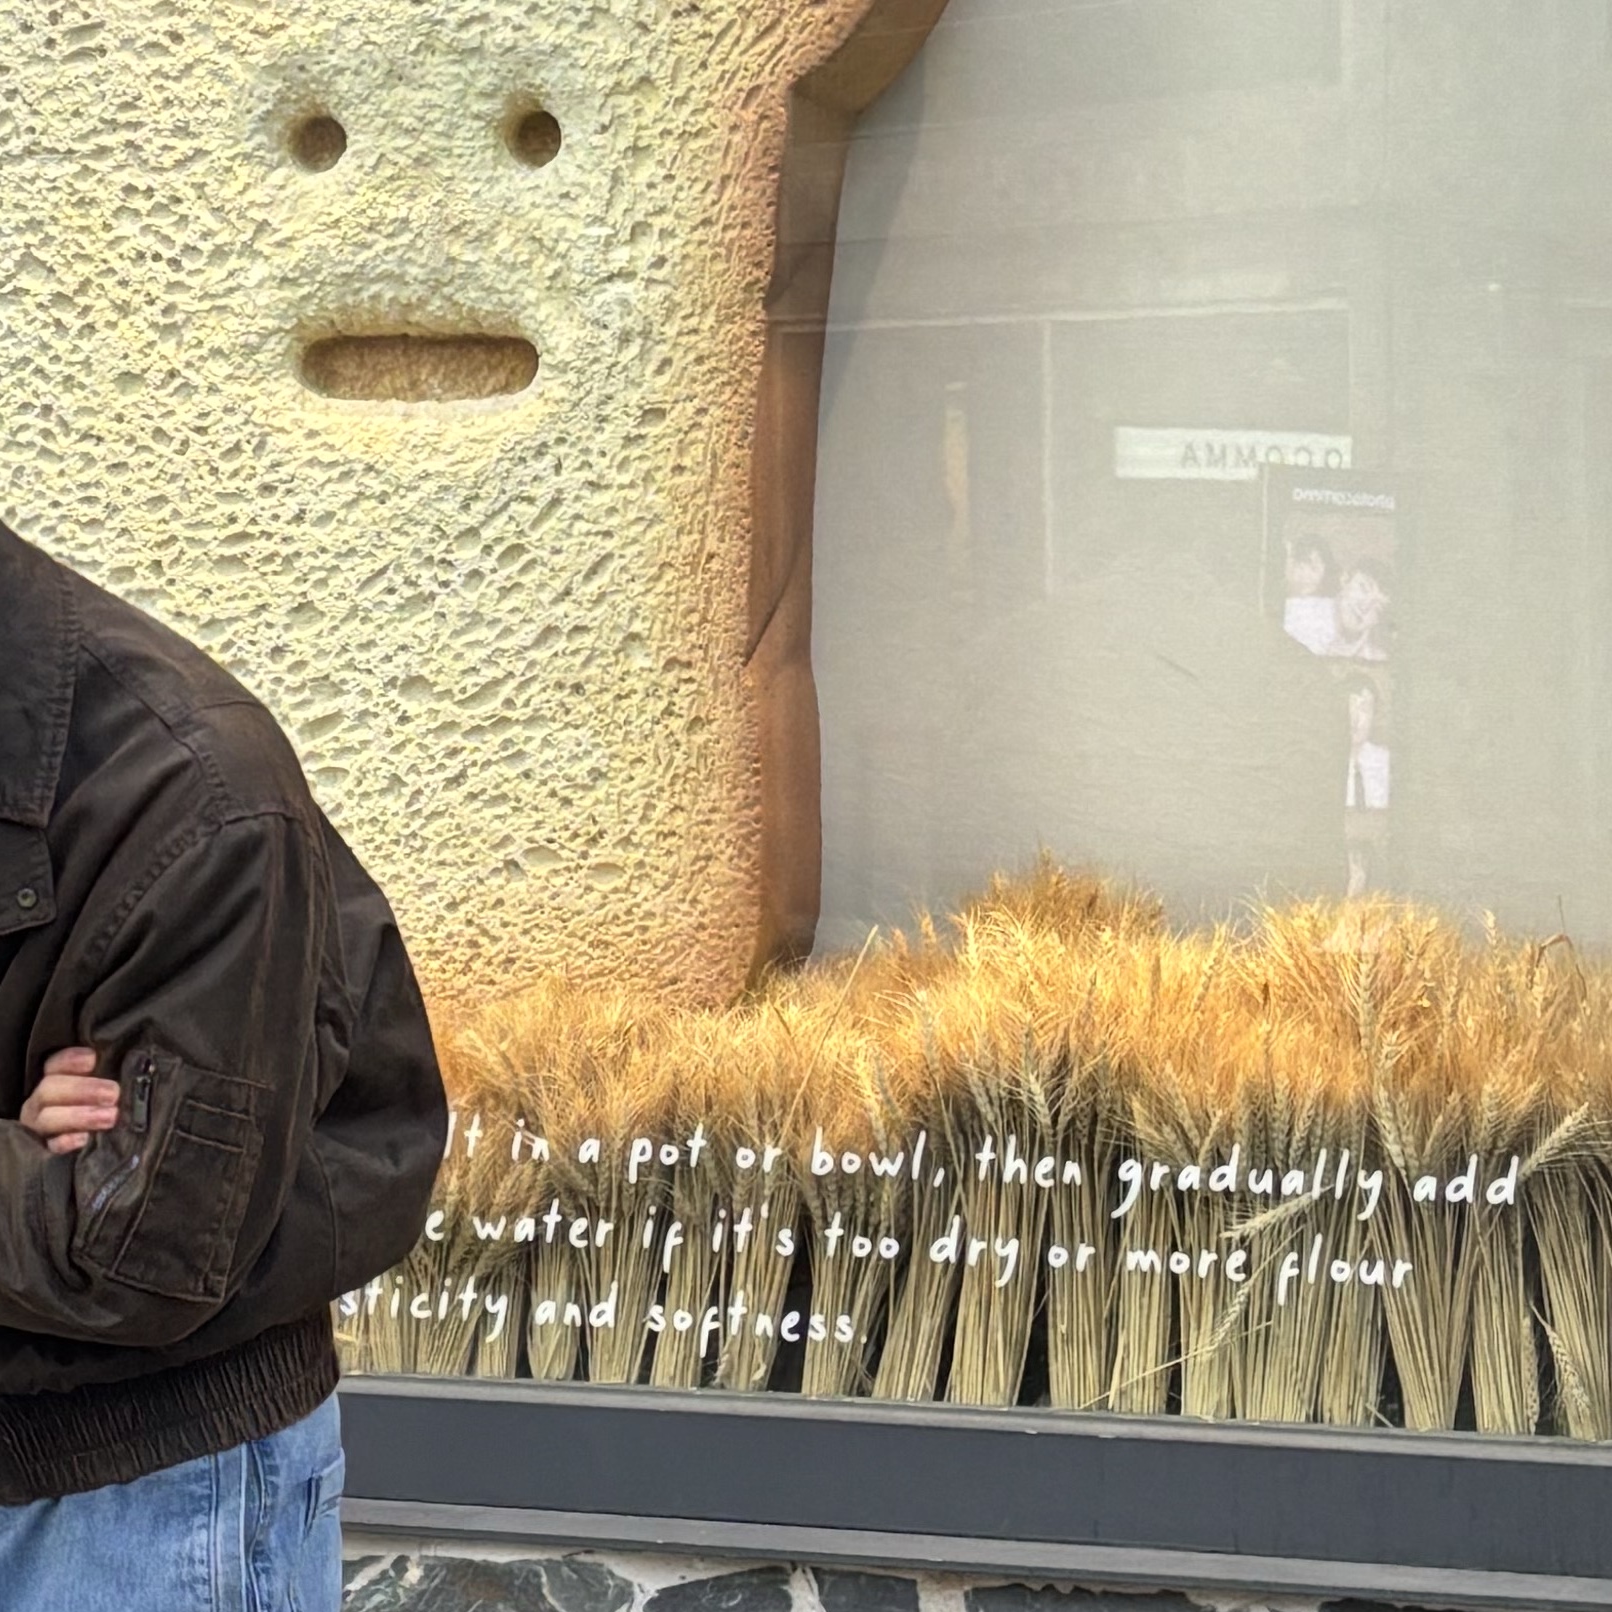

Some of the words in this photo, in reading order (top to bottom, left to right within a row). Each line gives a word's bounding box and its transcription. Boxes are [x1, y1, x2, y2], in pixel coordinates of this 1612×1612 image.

[443, 1111, 481, 1158] lt
[511, 1118, 550, 1162] in
[578, 1138, 601, 1164] a
[628, 1126, 707, 1184] pot
[735, 1145, 782, 1173] or
[811, 1130, 945, 1187] bowl,
[975, 1134, 1082, 1188] then
[1111, 1143, 1383, 1221] gradually
[1413, 1153, 1519, 1205] add
[472, 1198, 614, 1248] water
[642, 1206, 684, 1273] if
[712, 1203, 795, 1257] it's
[824, 1211, 900, 1259] too
[929, 1214, 1019, 1288] dry
[1048, 1242, 1096, 1273] or
[1125, 1248, 1247, 1282] more
[1277, 1233, 1413, 1307] flour
[339, 1275, 508, 1344] sticity
[534, 1282, 619, 1329] and
[645, 1289, 867, 1358] softness.
